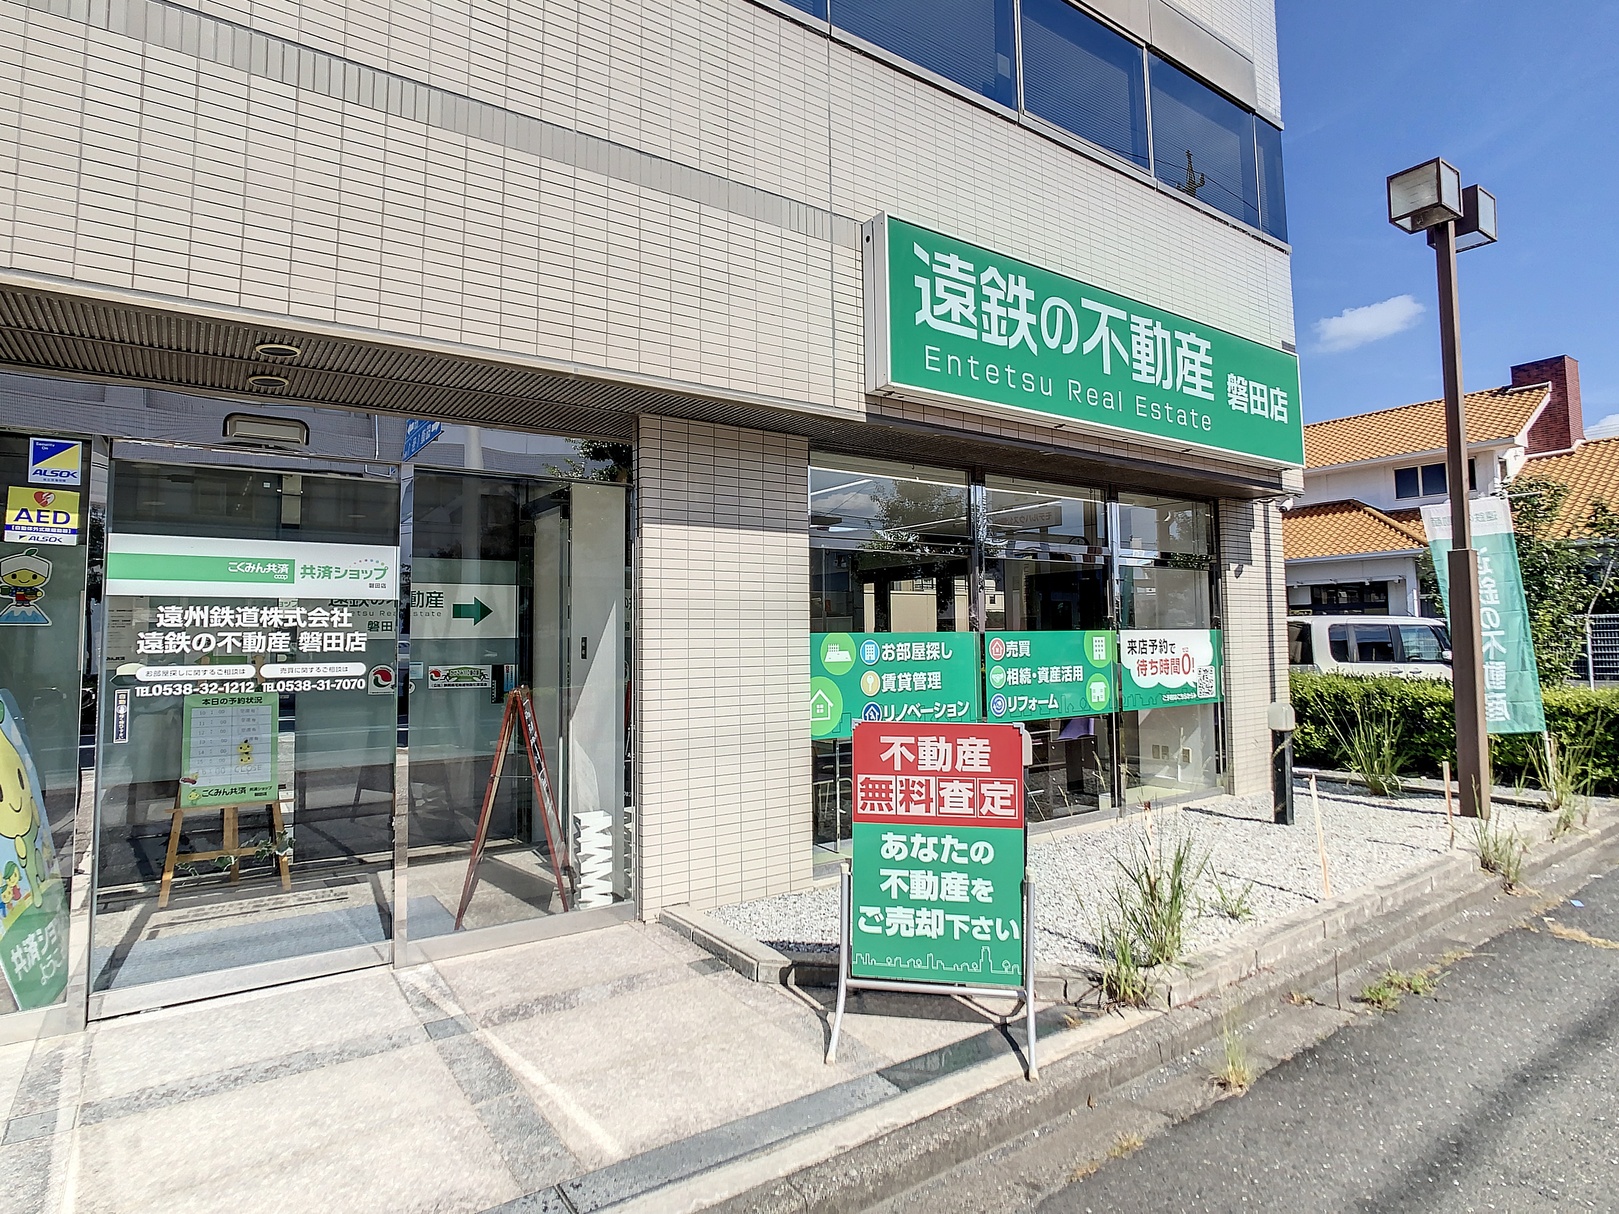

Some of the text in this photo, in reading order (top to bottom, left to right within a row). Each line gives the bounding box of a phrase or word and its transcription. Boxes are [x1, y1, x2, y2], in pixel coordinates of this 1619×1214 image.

[913, 241, 1215, 402] 遠鉄の不動産
[925, 344, 1213, 432] Entetsu Real Estate
[1226, 372, 1289, 425] 磐田店
[32, 469, 78, 479] ALSOK
[13, 508, 71, 525] AED
[28, 535, 63, 543] ALSOK
[228, 562, 289, 573] こくみん共済
[300, 564, 388, 581] 共済ショップ
[156, 605, 353, 628] 遠州鉄道株式会社
[136, 631, 368, 655] 遠鉄の不動産 磐田店
[880, 640, 954, 663] お部屋探し
[1005, 640, 1032, 658] 売買
[1126, 637, 1177, 656] 来店予約で
[881, 671, 943, 693] 賃貸管理
[1005, 666, 1085, 685] 相続・資産活用
[202, 696, 263, 706] 本日の予約状況
[882, 701, 971, 722] リノベーション
[1006, 694, 1060, 713] リフォーム
[879, 735, 992, 773] 不動産
[859, 777, 1017, 817] 無料査定
[880, 831, 995, 865] あなたの
[879, 868, 995, 904] 不動産を
[857, 905, 1020, 942] ご売却下さい
